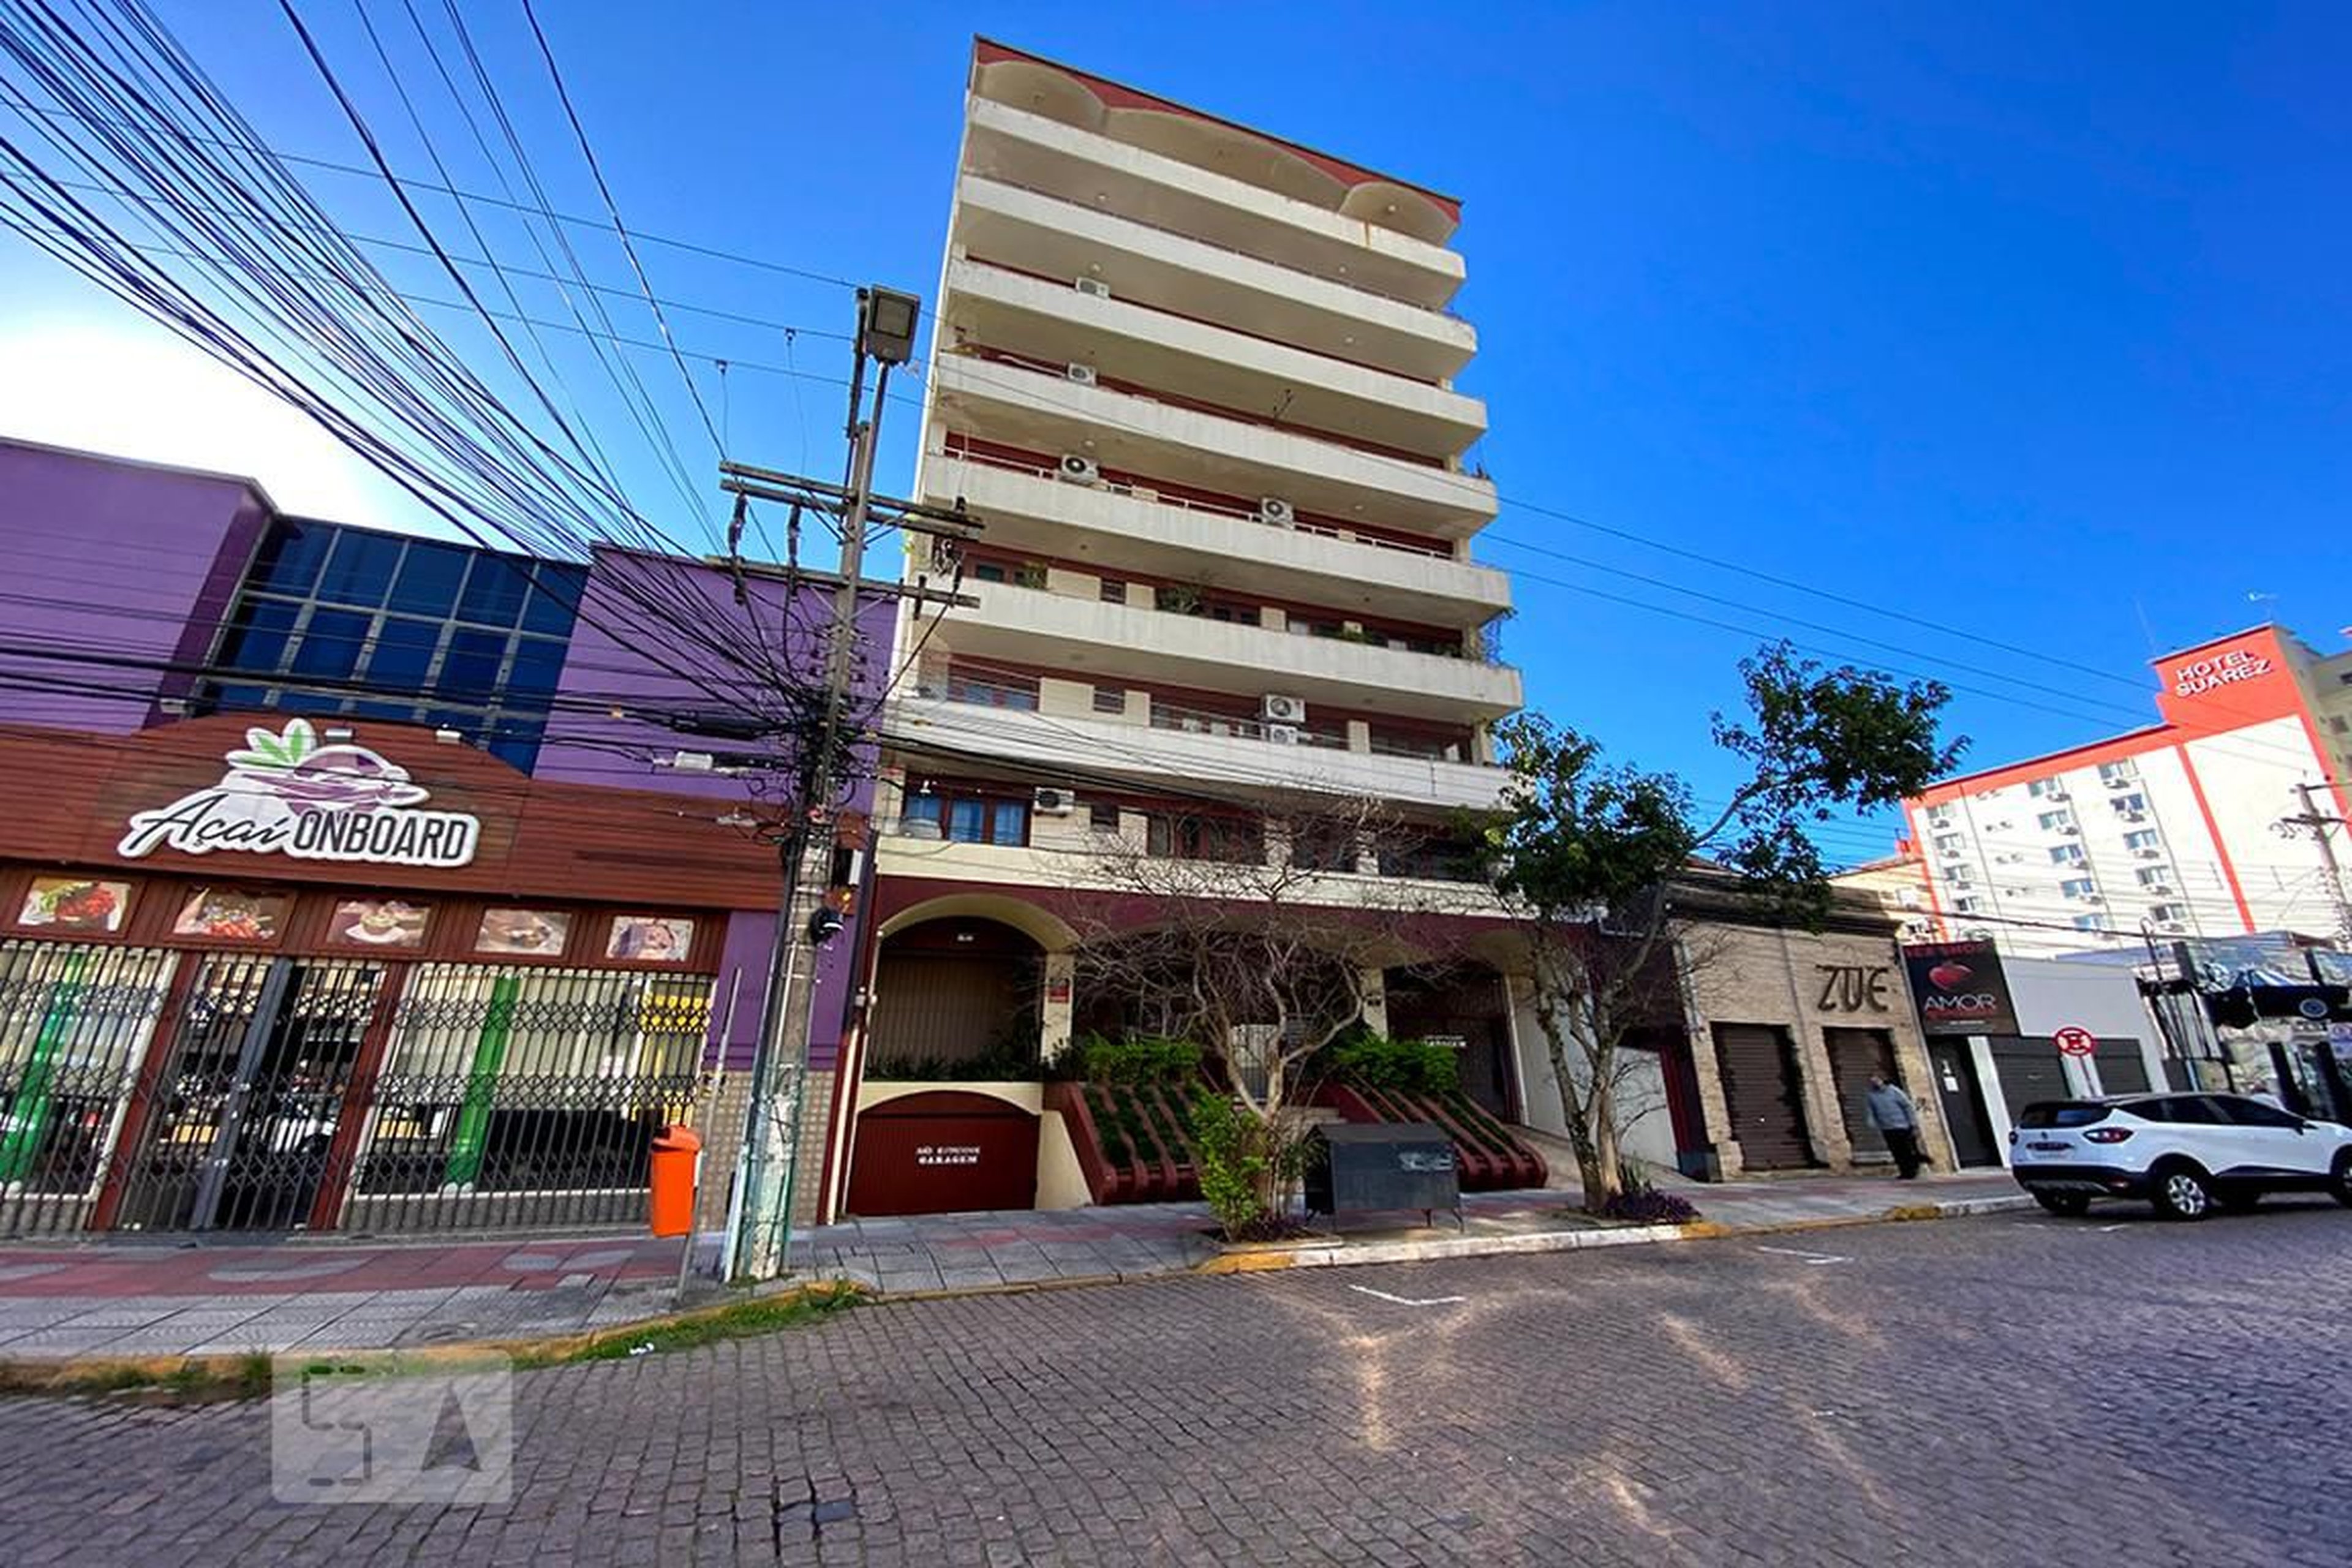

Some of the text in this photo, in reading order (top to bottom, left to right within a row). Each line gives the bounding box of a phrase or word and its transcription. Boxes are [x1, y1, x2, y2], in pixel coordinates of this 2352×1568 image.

[2176, 650, 2255, 681] HOTEL
[2176, 660, 2273, 698] SUAREZ
[293, 810, 469, 859] ONBOARD
[1815, 964, 1889, 1012] ZUE
[1924, 993, 1997, 1011] AMOR
